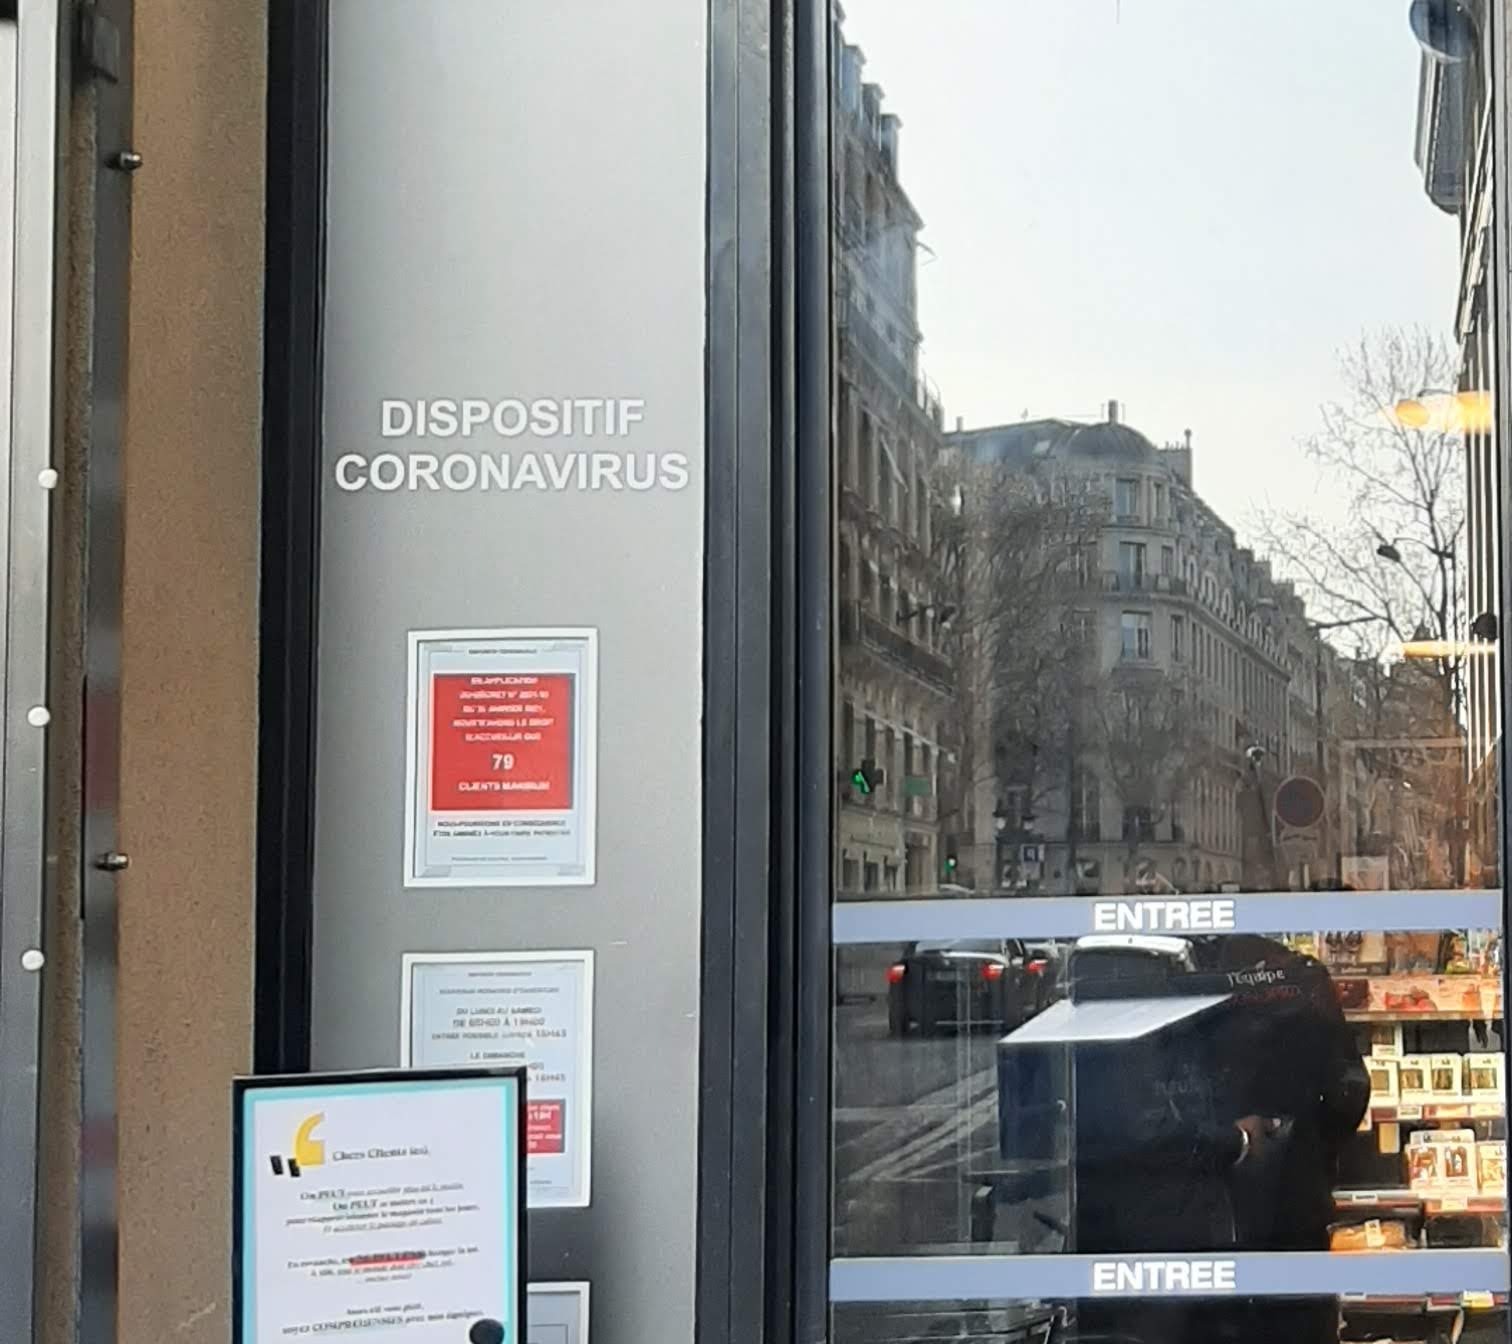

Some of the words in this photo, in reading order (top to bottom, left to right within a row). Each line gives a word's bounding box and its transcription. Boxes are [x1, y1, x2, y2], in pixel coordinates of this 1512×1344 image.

[380, 399, 646, 437] DISPOSITIF
[334, 452, 690, 492] CORONAVIRUS
[492, 754, 515, 772] 79
[1093, 899, 1236, 931] ENTREE
[1092, 1260, 1236, 1292] ENTREE
